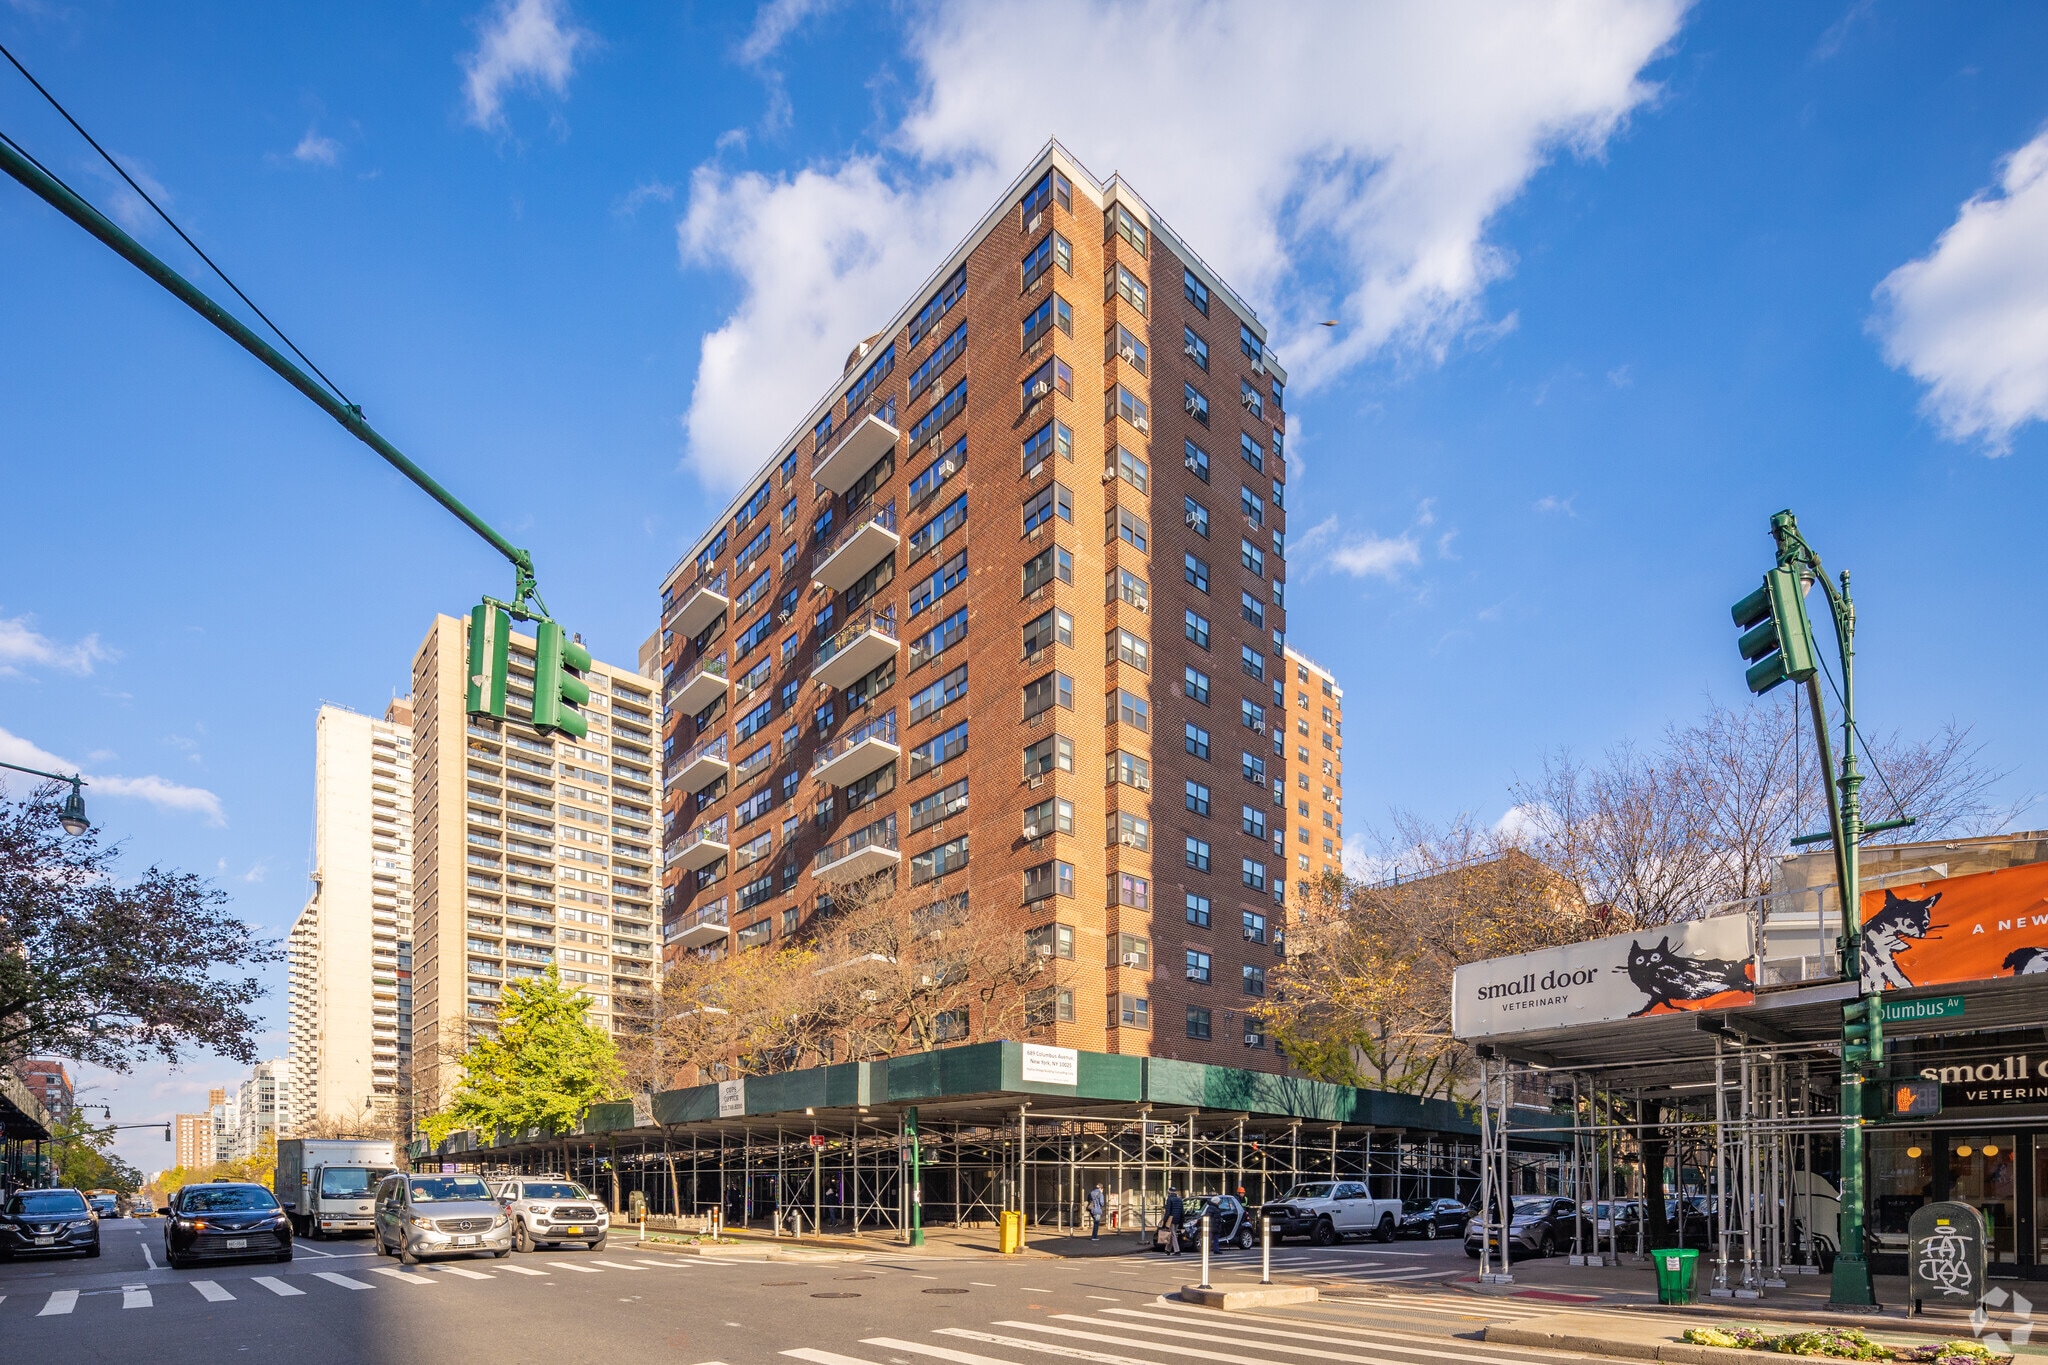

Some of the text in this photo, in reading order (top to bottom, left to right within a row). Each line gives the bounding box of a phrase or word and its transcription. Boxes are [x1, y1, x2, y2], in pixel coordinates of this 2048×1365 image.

[1972, 914, 2048, 935] A NEW
[1478, 968, 1598, 1000] small door
[1502, 995, 1568, 1012] VETERINARY
[1881, 998, 1959, 1020] olumbus Av
[1920, 1055, 2030, 1084] small
